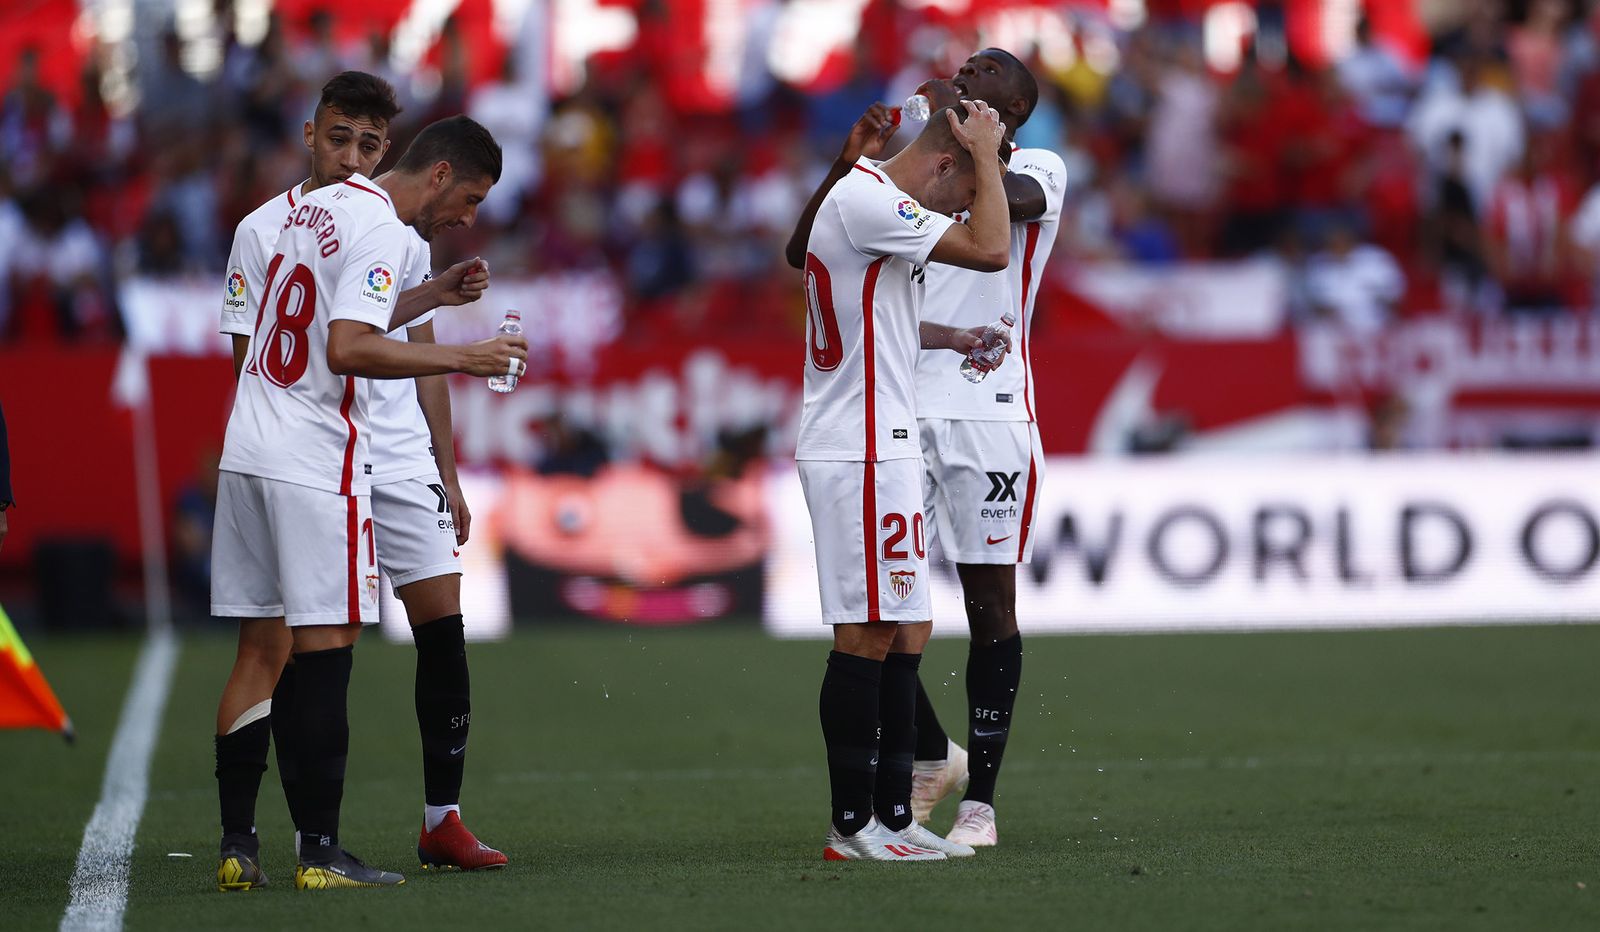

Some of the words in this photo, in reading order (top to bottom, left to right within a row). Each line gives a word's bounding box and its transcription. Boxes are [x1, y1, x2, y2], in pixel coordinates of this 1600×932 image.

[362, 290, 388, 304] LaLiga
[245, 252, 316, 389] 18
[981, 505, 1017, 519] everfx
[881, 512, 925, 561] 20
[1030, 503, 1474, 586] WORLD
[975, 707, 999, 721] SFC
